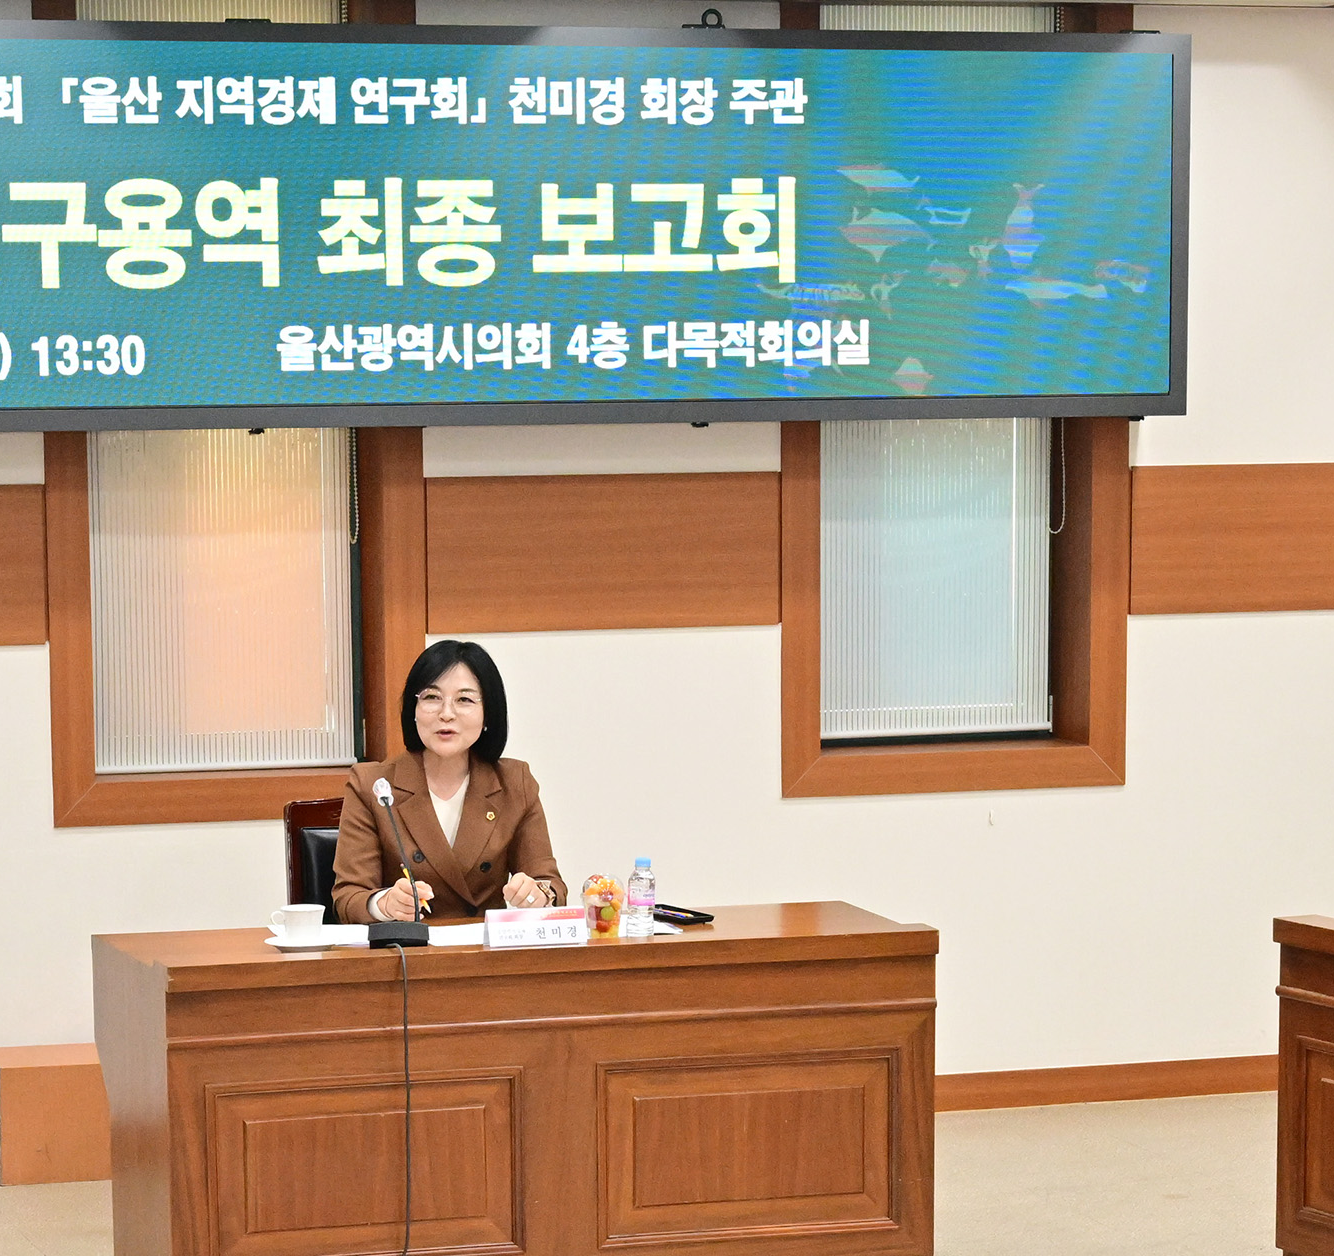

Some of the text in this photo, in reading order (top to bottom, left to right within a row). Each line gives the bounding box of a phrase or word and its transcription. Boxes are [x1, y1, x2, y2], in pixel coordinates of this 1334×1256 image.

[176, 76, 337, 126] 지역경제
[509, 77, 626, 127] 천미경
[641, 78, 719, 127] 회장
[730, 79, 809, 126] 주관
[318, 178, 503, 288] 최종
[533, 177, 798, 284] 보고회
[31, 334, 147, 378] 13:30
[277, 320, 871, 373] 울산광역시의회 4층 다목적회의실
[535, 925, 577, 940] 천미경
